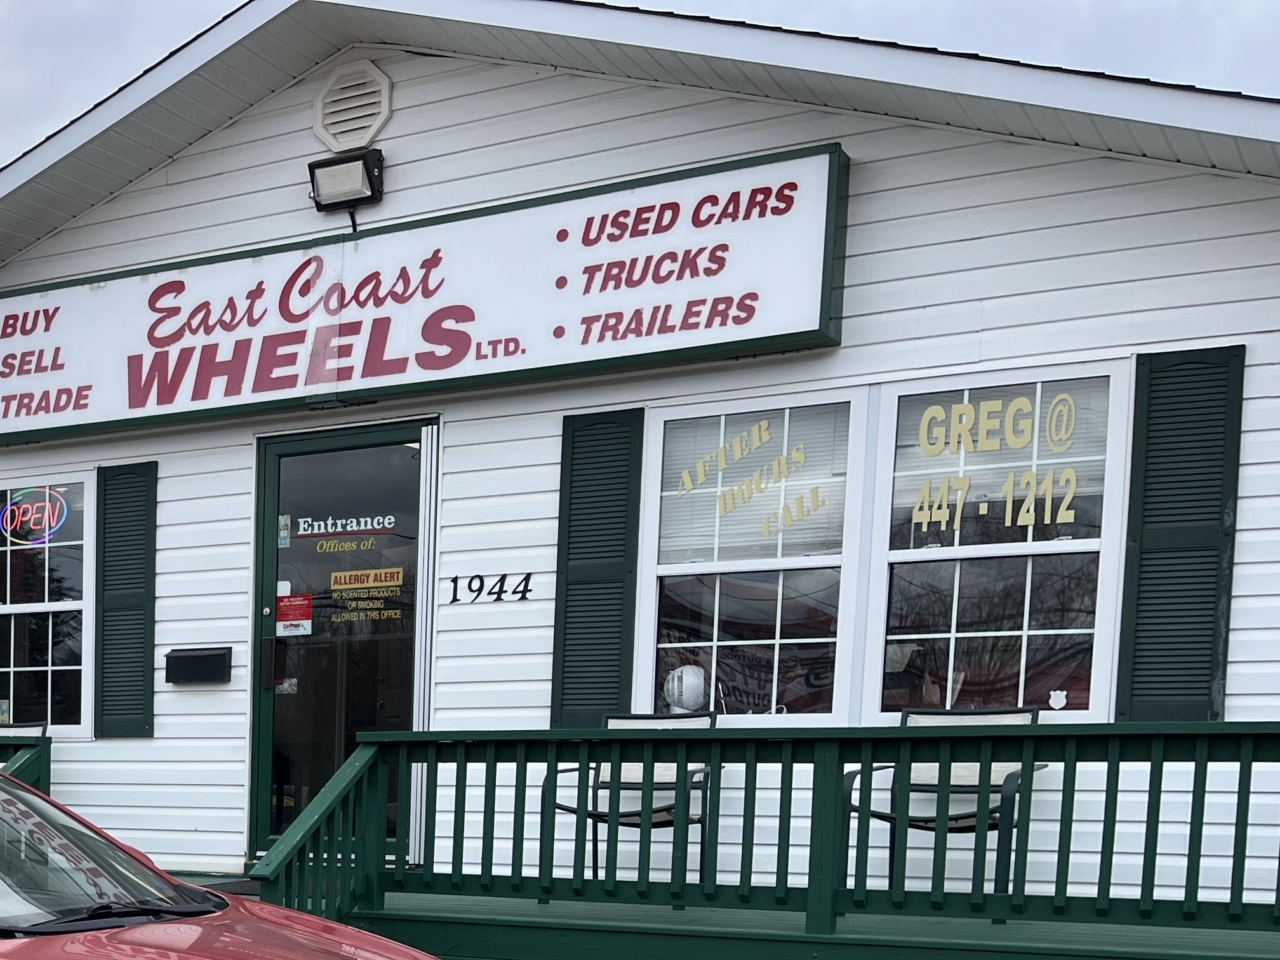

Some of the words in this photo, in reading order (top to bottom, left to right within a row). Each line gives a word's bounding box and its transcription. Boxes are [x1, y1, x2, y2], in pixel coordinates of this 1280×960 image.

[581, 201, 681, 247] USED
[691, 181, 799, 229] CARS
[582, 243, 730, 295] TRUCKS
[147, 279, 268, 349] East
[278, 248, 445, 324] Coast
[0, 306, 60, 339] BUY
[580, 292, 760, 345] TRAILERS
[0, 347, 65, 379] SELL
[127, 305, 476, 409] WHEELS
[476, 337, 527, 361] LTD.
[1, 384, 93, 419] TRADE
[920, 396, 1034, 456] GREG
[1045, 392, 1077, 454] @
[677, 418, 773, 498] AFTER
[717, 442, 807, 517] HOURS
[3, 501, 60, 531] OPEN
[762, 486, 826, 539] CALL
[914, 476, 971, 532] 447
[1001, 468, 1077, 527] 1212
[297, 515, 395, 535] Entrance
[316, 539, 357, 553] Offices
[360, 537, 376, 550] of:
[332, 591, 341, 600] NO
[342, 589, 369, 600] SCENTED
[370, 588, 401, 598] PRODUCTS
[333, 573, 371, 586] ALLERGY
[373, 571, 401, 583] ALERT
[449, 572, 533, 605] 1944
[331, 613, 358, 622] ALLOWED
[367, 611, 379, 620] THIS
[381, 610, 402, 619] OFFICE
[348, 601, 357, 610] OR
[358, 600, 384, 609] SMOKING
